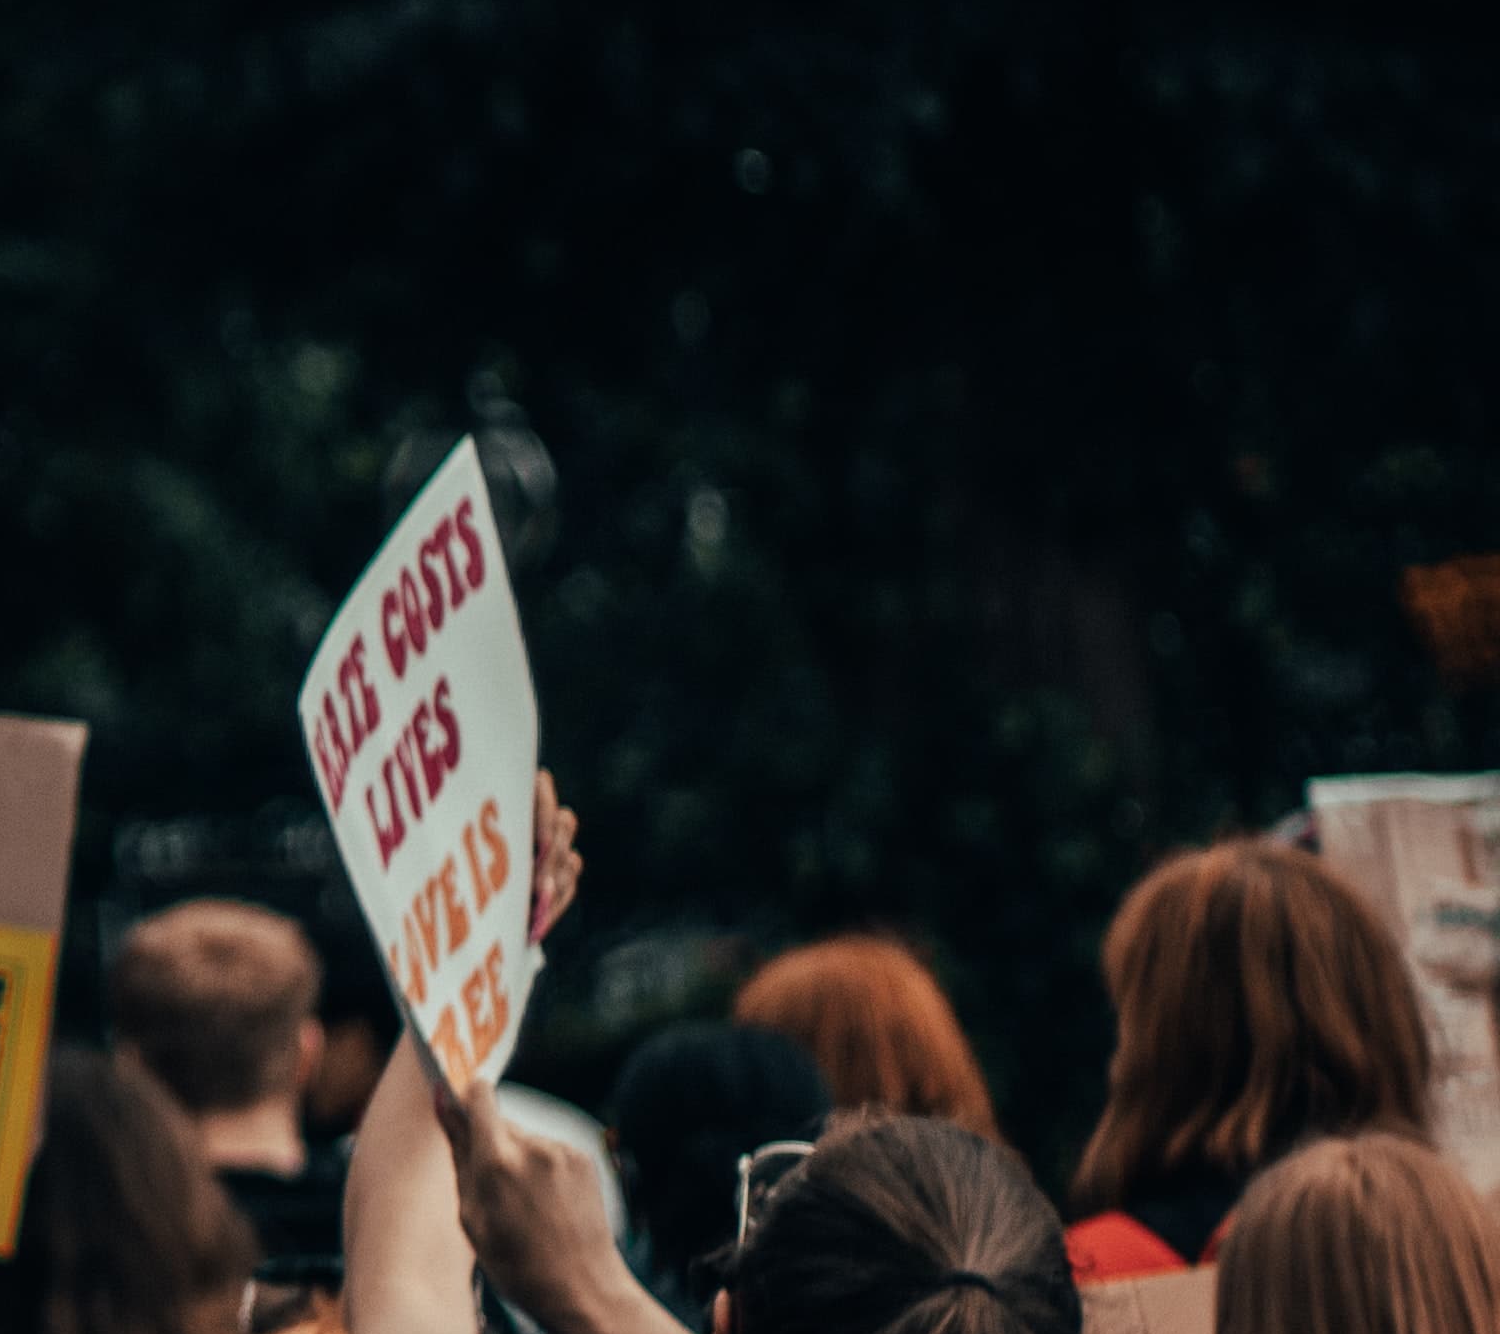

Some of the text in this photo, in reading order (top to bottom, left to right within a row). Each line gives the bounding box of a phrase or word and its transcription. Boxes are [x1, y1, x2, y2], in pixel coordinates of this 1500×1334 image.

[381, 496, 485, 680] COSTS
[366, 675, 461, 873] LIVES
[461, 796, 510, 914] IS
